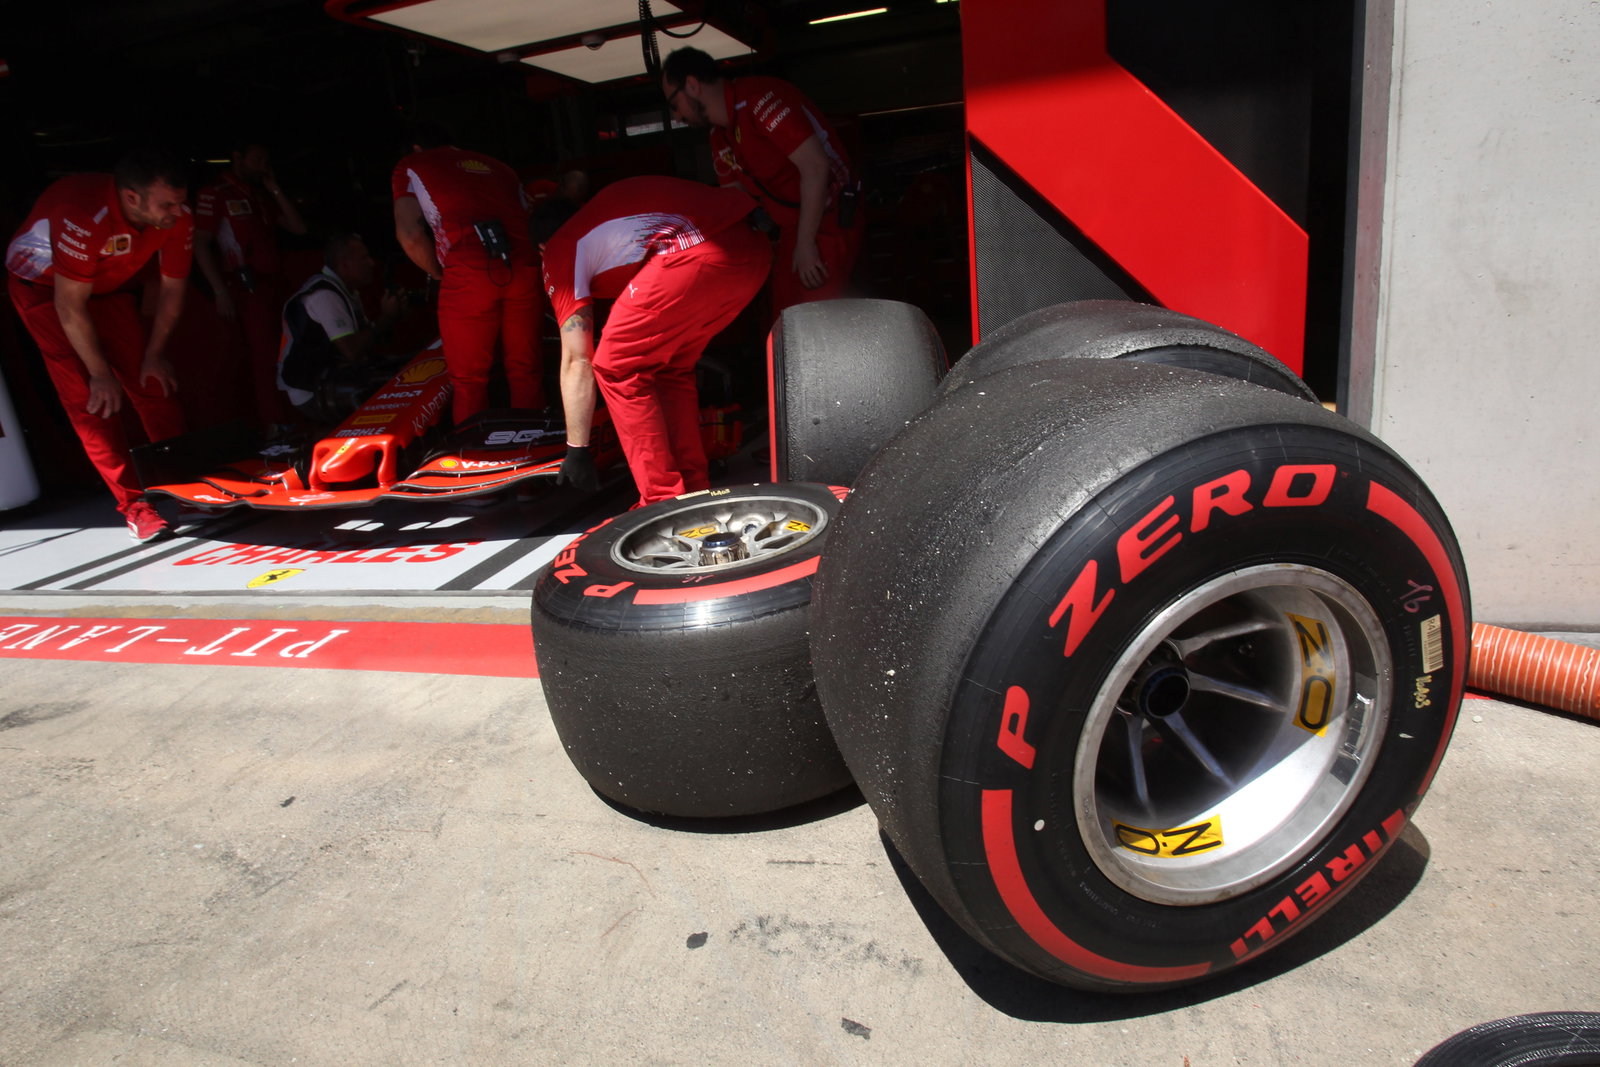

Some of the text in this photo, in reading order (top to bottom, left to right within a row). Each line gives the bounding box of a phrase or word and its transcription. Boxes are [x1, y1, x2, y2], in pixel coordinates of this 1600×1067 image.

[766, 107, 790, 132] Lenovo
[462, 456, 532, 469] V-Power
[583, 581, 635, 598] P
[997, 685, 1036, 769] P
[1048, 463, 1337, 657] ZERO
